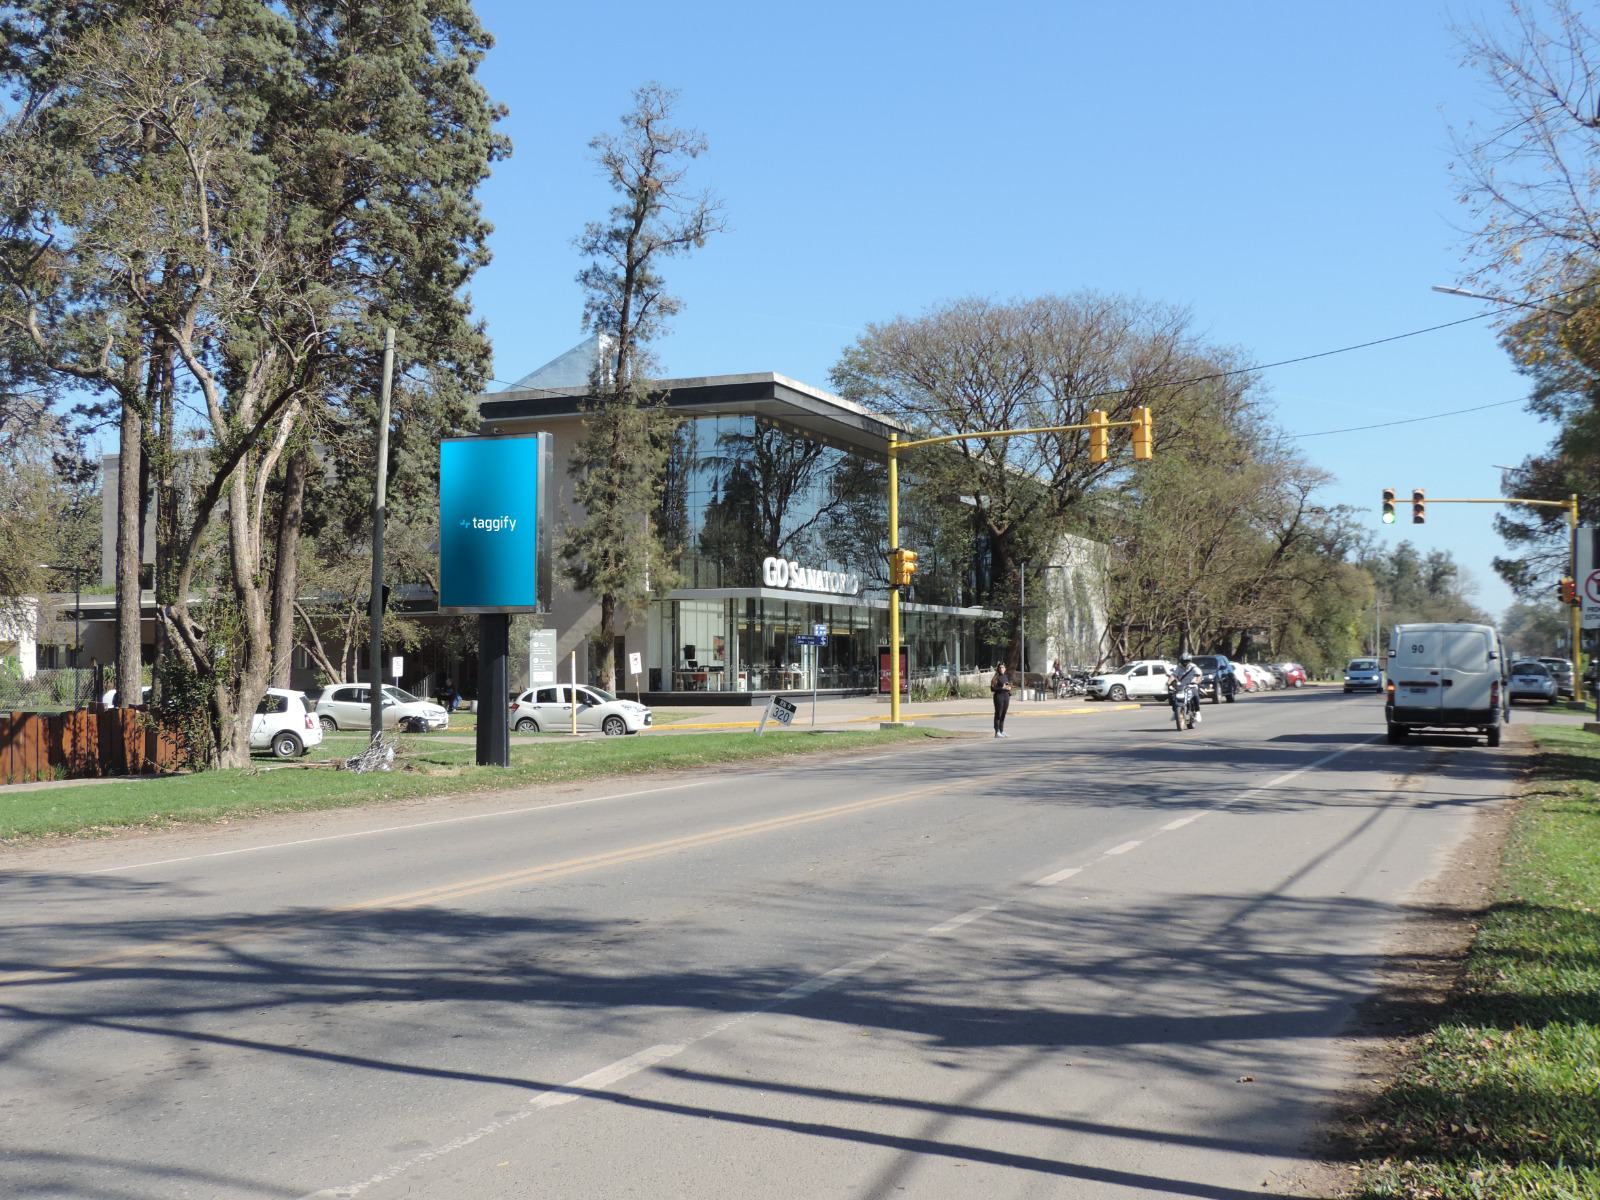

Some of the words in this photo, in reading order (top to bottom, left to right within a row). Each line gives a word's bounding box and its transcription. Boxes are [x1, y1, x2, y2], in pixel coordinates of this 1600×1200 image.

[472, 515, 517, 532] taggify
[763, 557, 789, 588] GO
[1411, 644, 1425, 654] 90
[772, 706, 790, 723] 320
